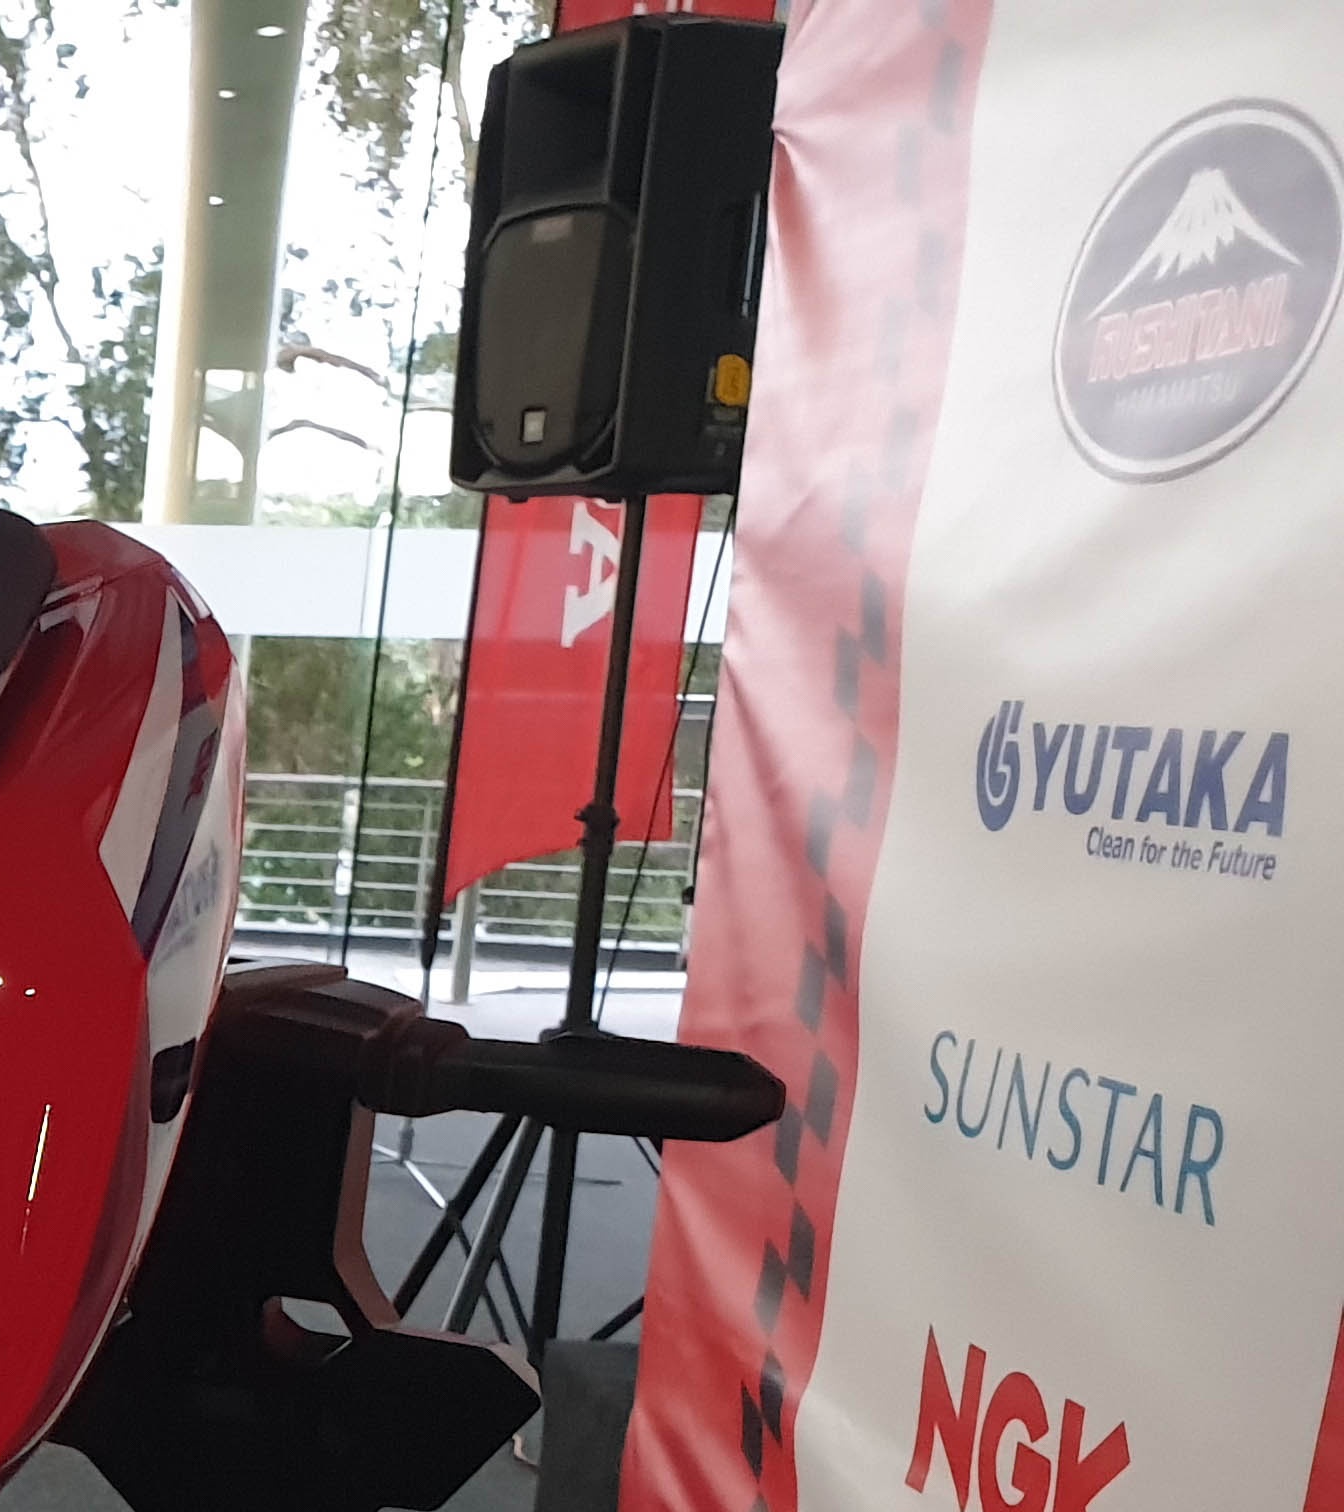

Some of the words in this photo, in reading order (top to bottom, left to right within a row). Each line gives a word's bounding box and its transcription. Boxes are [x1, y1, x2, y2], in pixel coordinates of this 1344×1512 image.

[1031, 721, 1290, 837] YUTAKA
[1085, 825, 1135, 861] Clean
[1139, 834, 1168, 865] for
[1170, 838, 1203, 870] the
[1206, 840, 1277, 881] Future
[923, 1029, 1225, 1227] SUNSTAR
